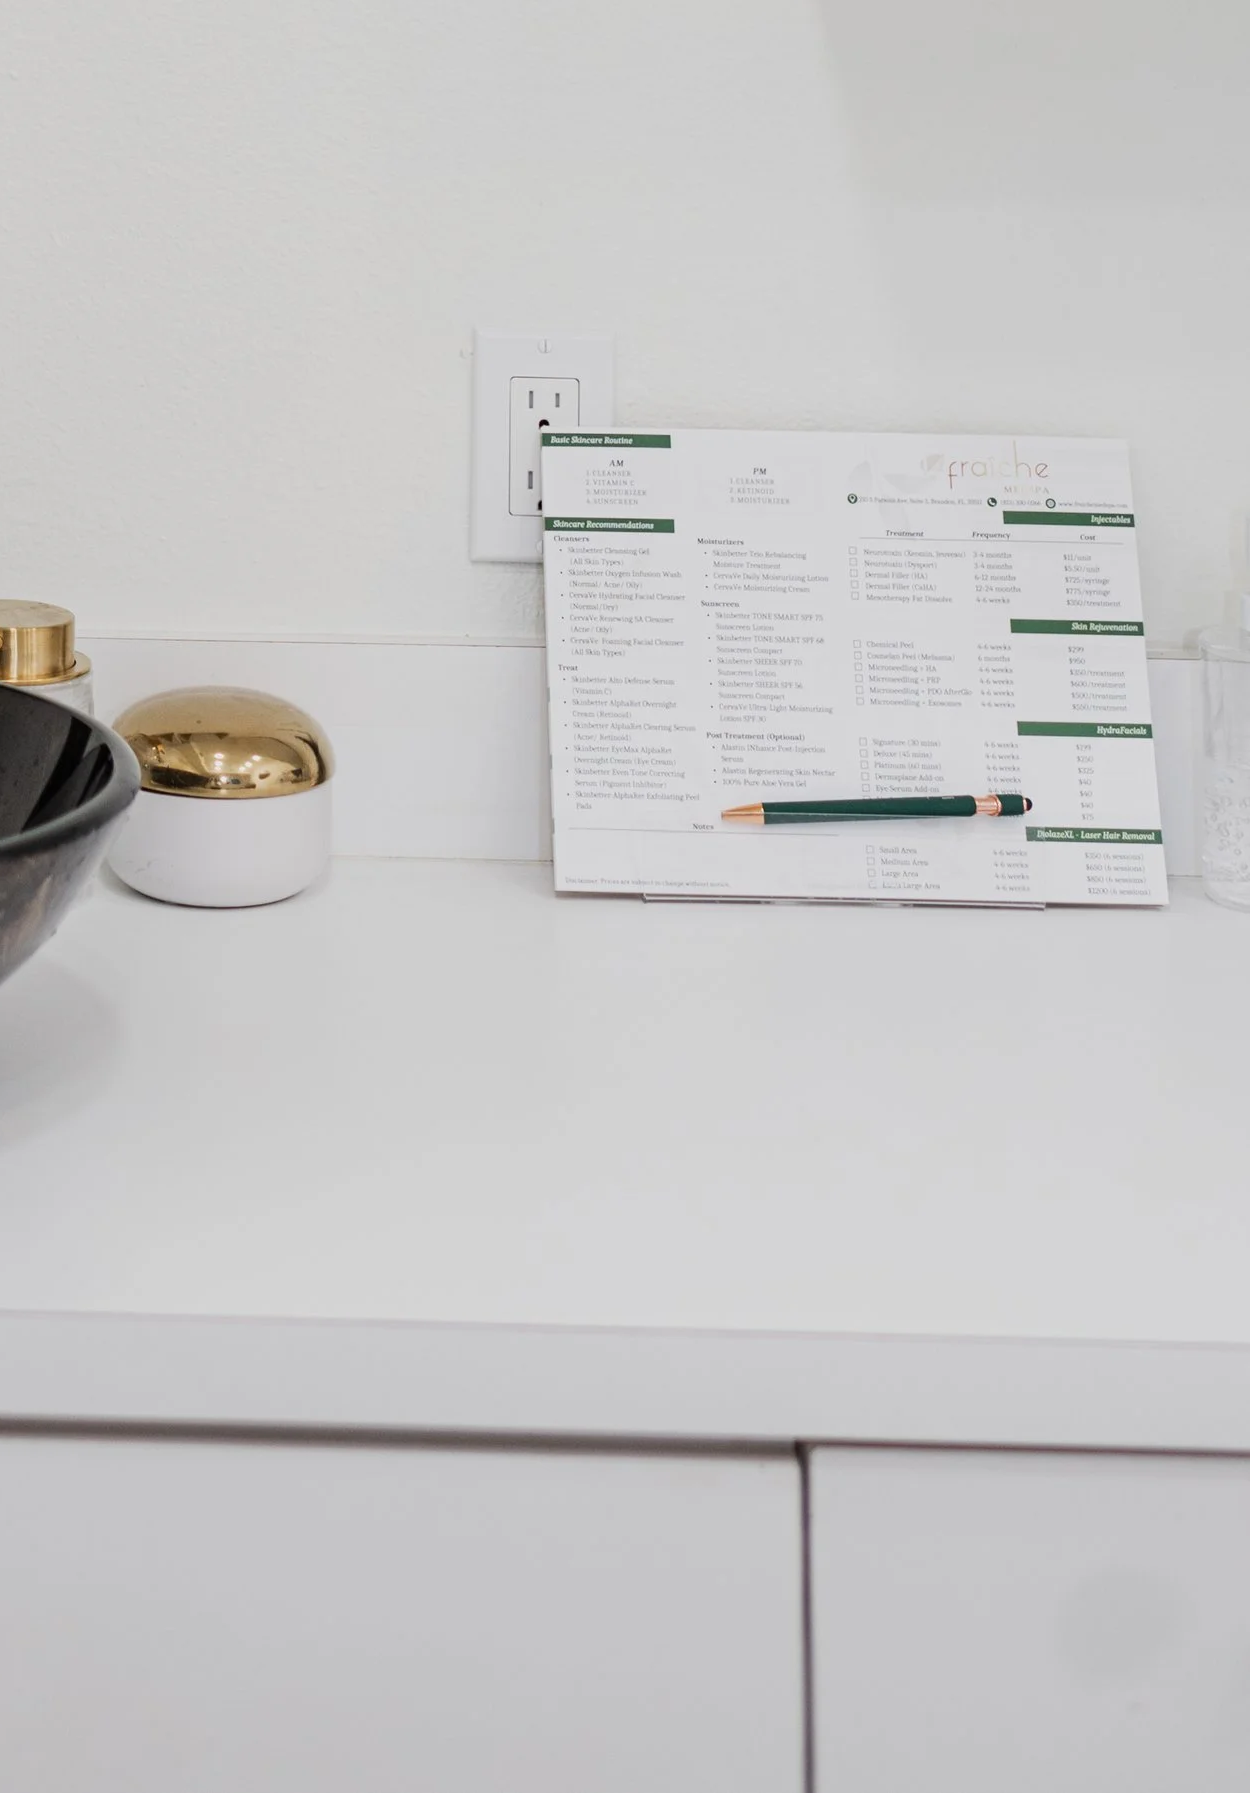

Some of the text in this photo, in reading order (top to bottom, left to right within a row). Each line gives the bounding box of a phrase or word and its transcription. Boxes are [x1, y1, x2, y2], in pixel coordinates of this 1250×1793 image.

[551, 435, 633, 444] Basic Skincare Routine
[553, 519, 654, 529] Skincare Recommendations
[1091, 514, 1131, 526] Injectables
[972, 531, 1010, 540] Frequency
[697, 537, 744, 545] Moisturizers
[1072, 622, 1138, 634] Skin Rejuvenation
[1097, 725, 1147, 737] HydraFacials
[725, 732, 764, 740] Treatment
[766, 732, 805, 742] (Optional)
[1081, 830, 1101, 839] Laser
[1103, 831, 1120, 839] Hair
[1122, 831, 1155, 840] Removal
